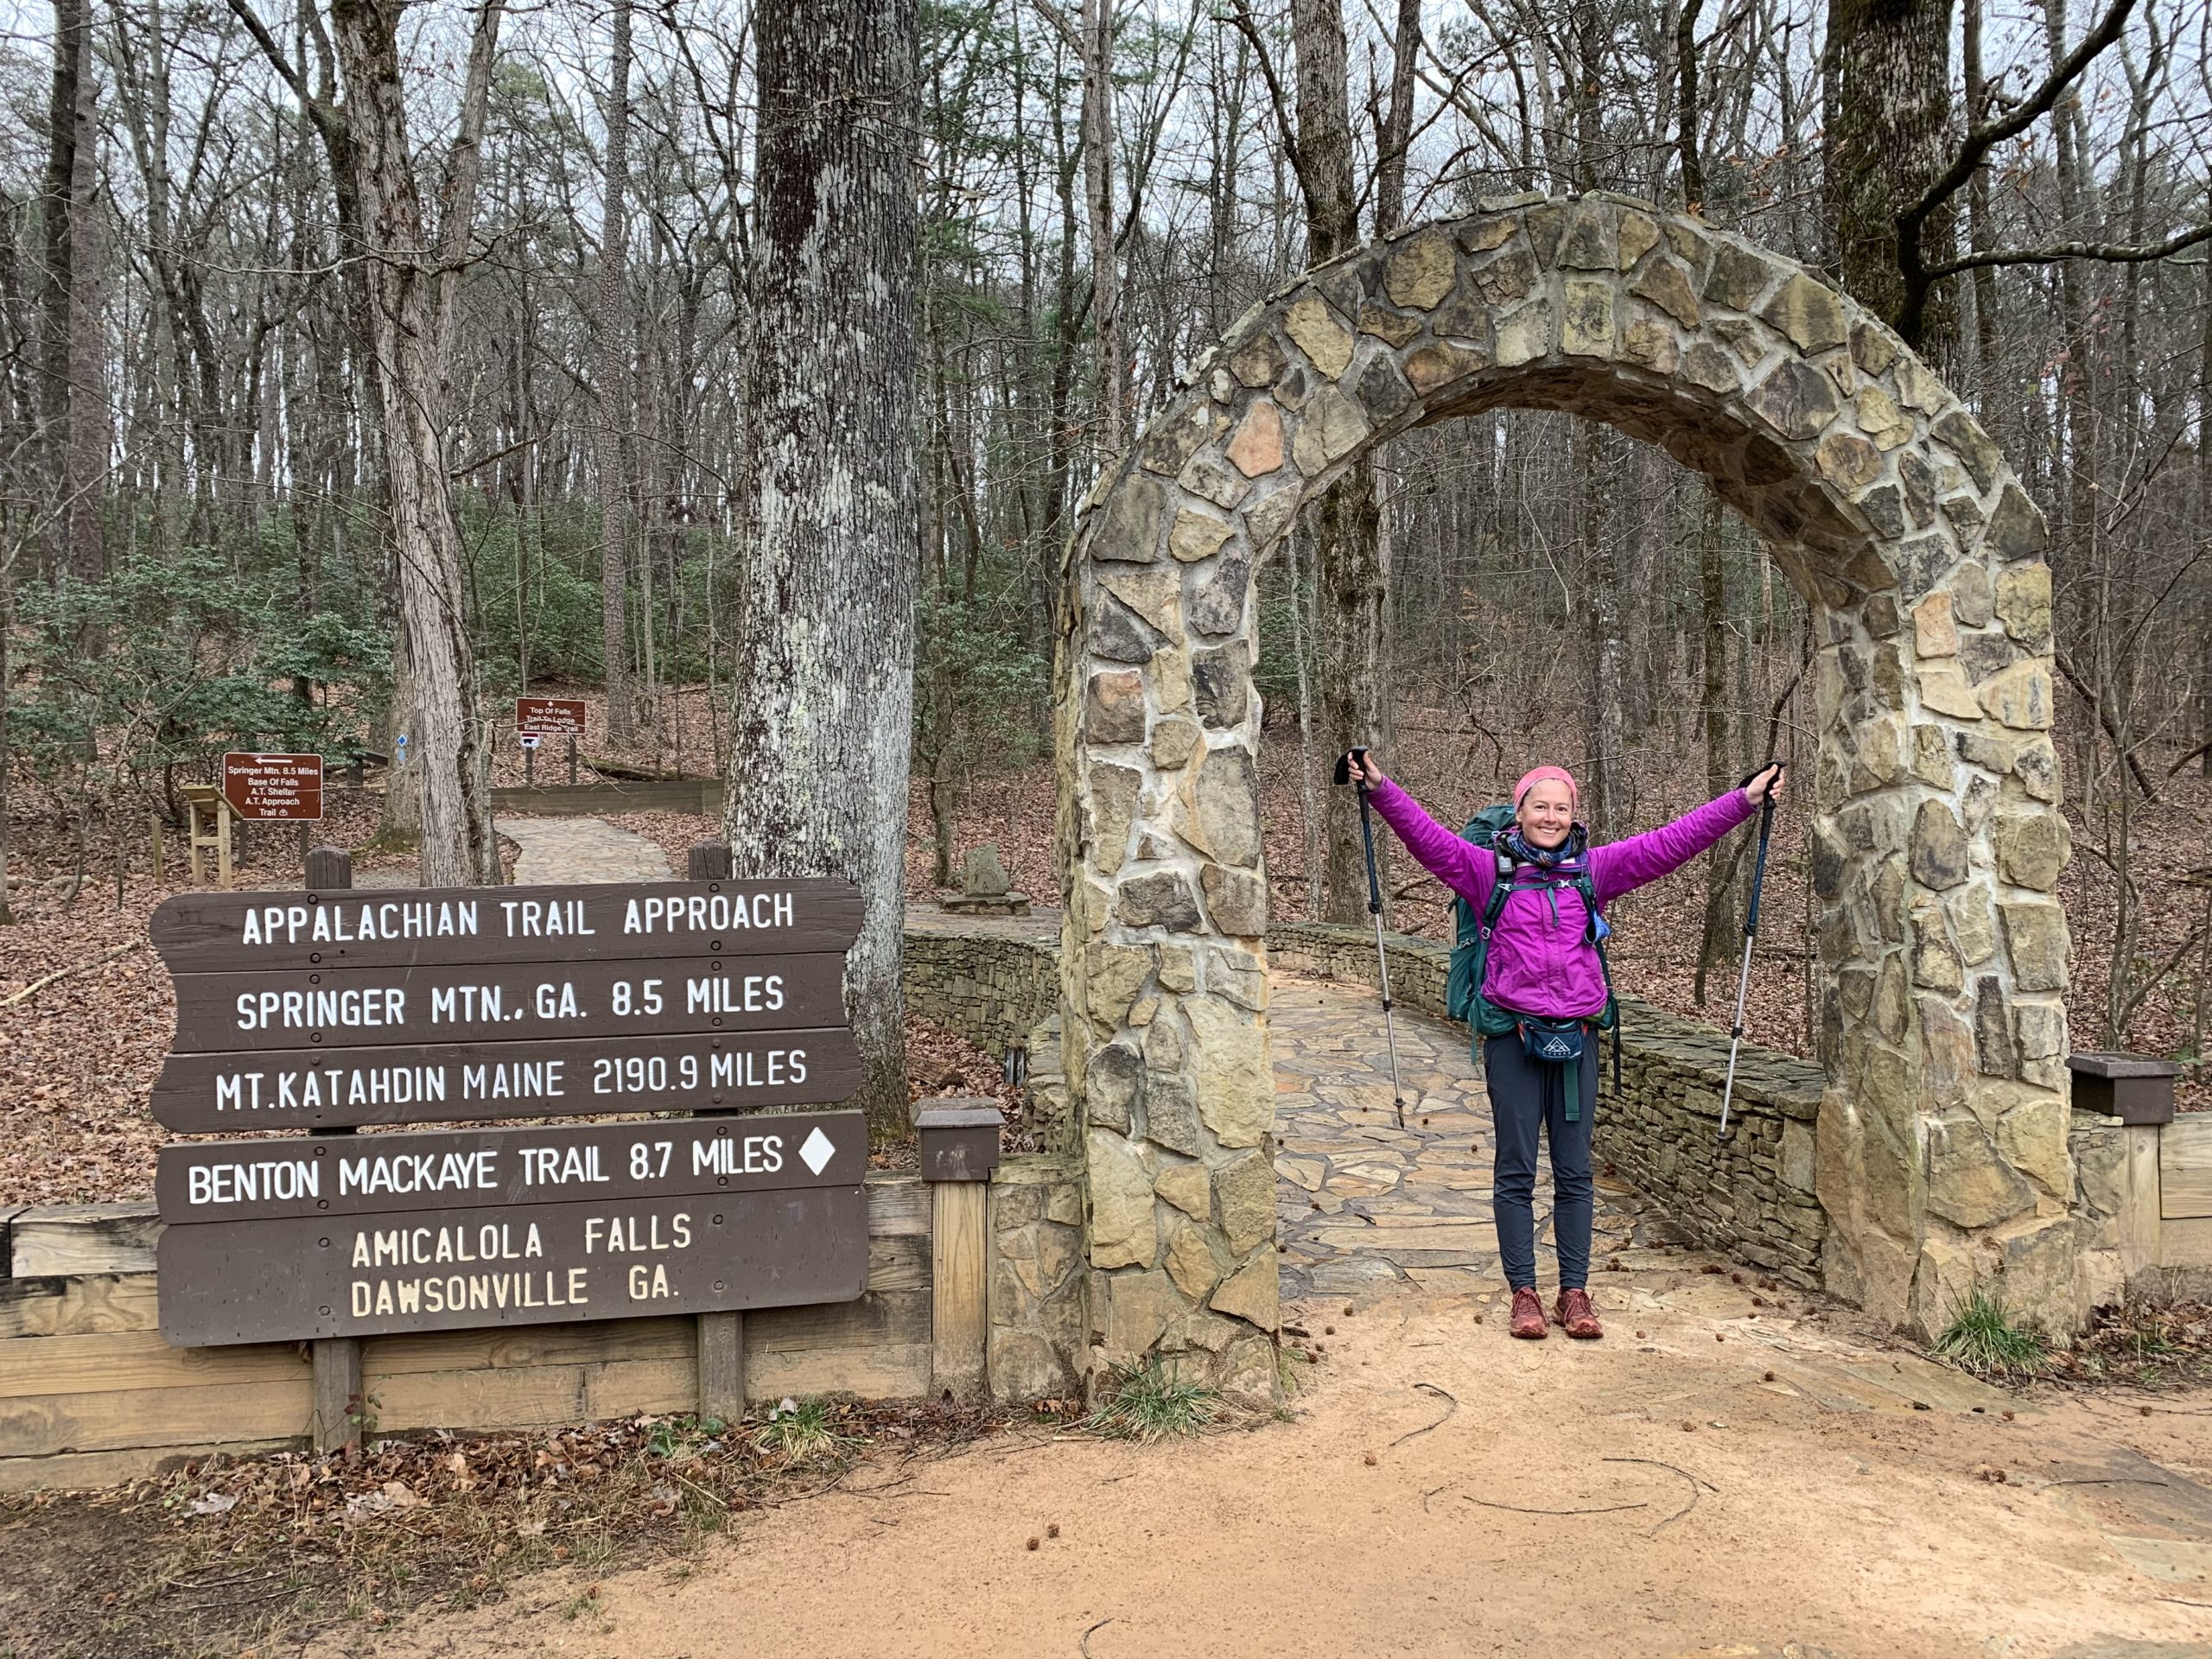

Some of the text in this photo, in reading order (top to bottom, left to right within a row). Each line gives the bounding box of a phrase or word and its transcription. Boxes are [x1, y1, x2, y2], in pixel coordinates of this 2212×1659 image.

[228, 766, 263, 775] Springer
[262, 798, 300, 806] Approach
[242, 892, 793, 944] APPALACHIAN TRAIL APPROACH
[237, 987, 405, 1032] SPRINGER
[536, 981, 588, 1019] GA.
[612, 979, 663, 1017] 8.5
[687, 975, 785, 1014] MILES
[463, 1059, 565, 1100] MAINE
[594, 1055, 698, 1095] 2190.9
[710, 1049, 807, 1088] MILES
[188, 1135, 783, 1205] BENTON MACKAYE TRAIL 8.7 MILES
[352, 1212, 691, 1268] AMICALOLA FALLS
[352, 1263, 680, 1318] DAWSONVILLE GA.
